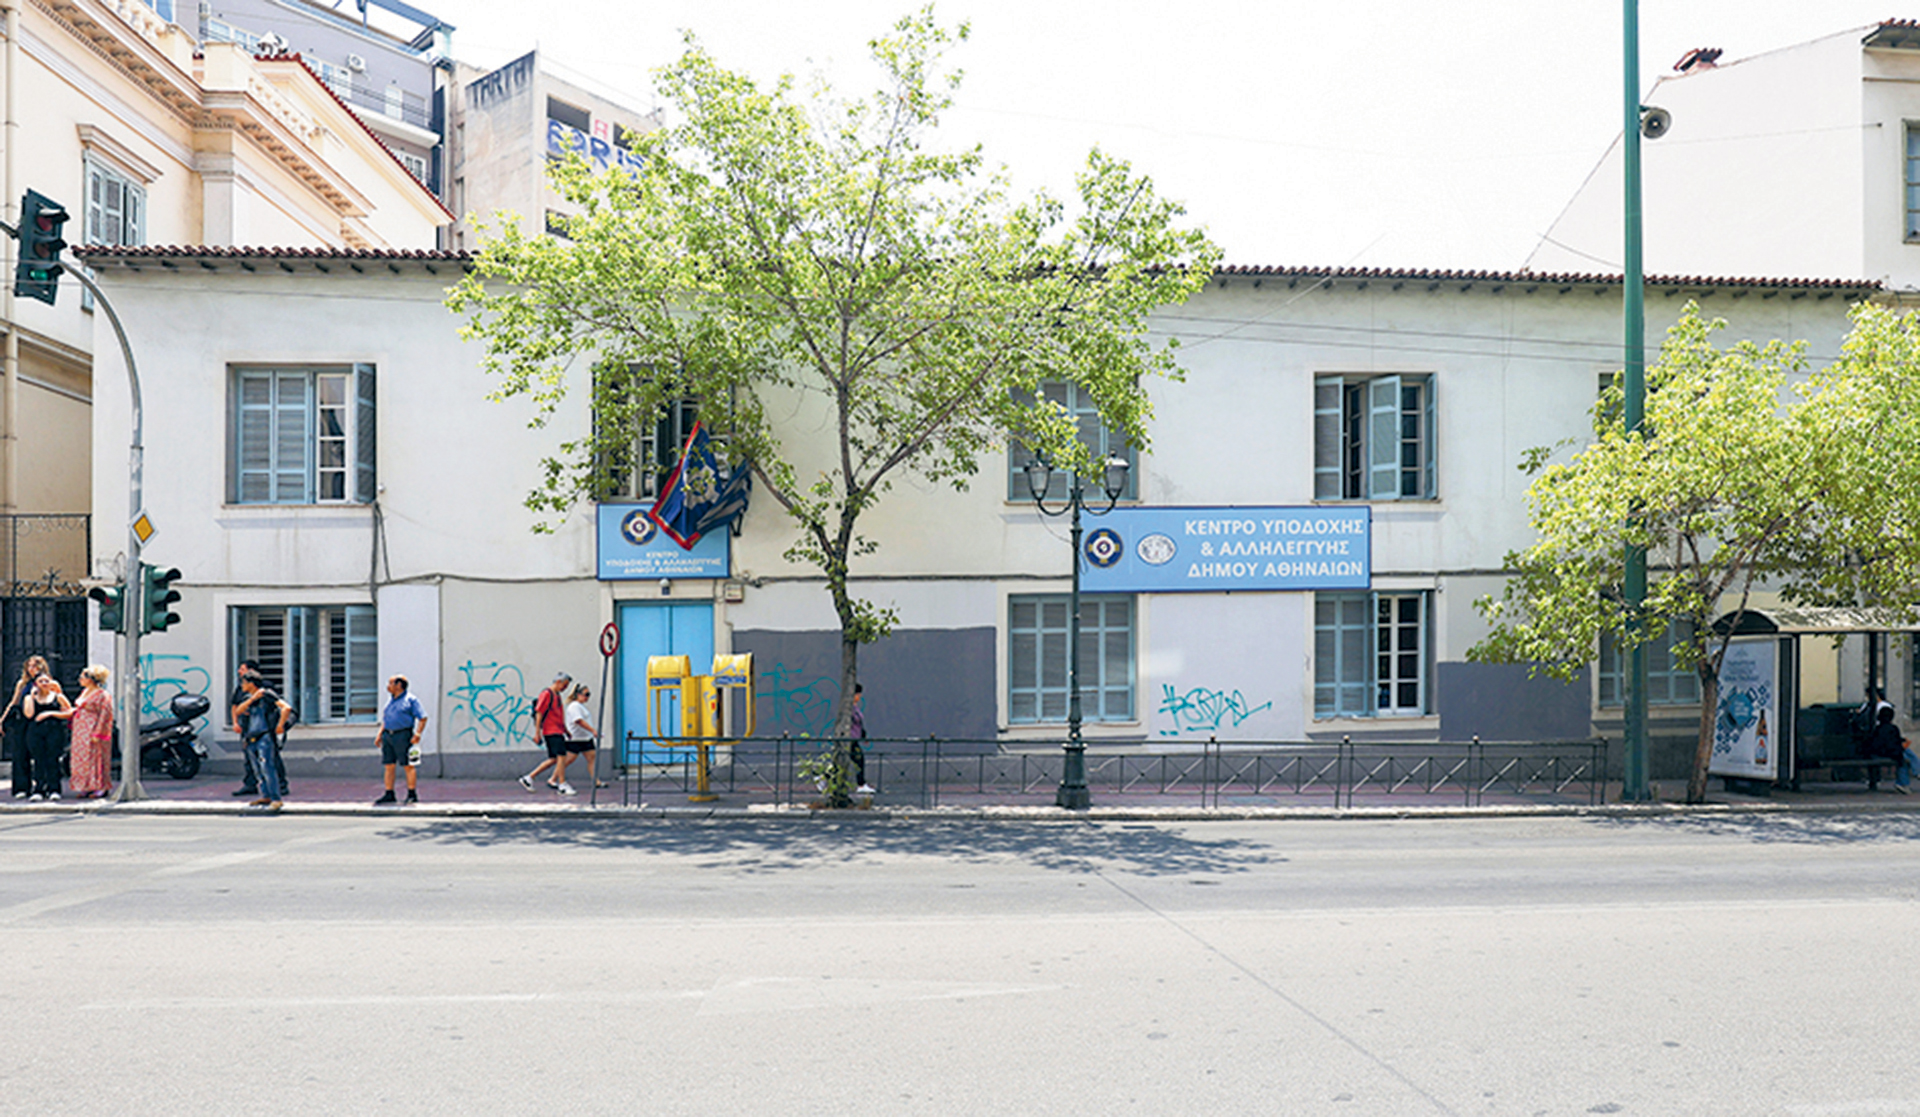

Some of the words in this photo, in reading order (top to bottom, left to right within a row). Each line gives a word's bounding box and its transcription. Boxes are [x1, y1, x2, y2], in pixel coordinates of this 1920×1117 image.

[1185, 519, 1256, 535] ΚΕΝΤΡΟ
[1262, 519, 1364, 534] ΥΠΟΔΟΧΗΣ
[645, 551, 679, 559] ΚΕΝΤΡΟ
[1201, 541, 1214, 555] &
[1219, 540, 1350, 556] ΑΛΛΗΛΕΓΓΥΗΣ
[1188, 562, 1258, 577] ΔΗΜΟΥ
[1264, 561, 1363, 577] ΑΘΗΝΑΙΩΝ
